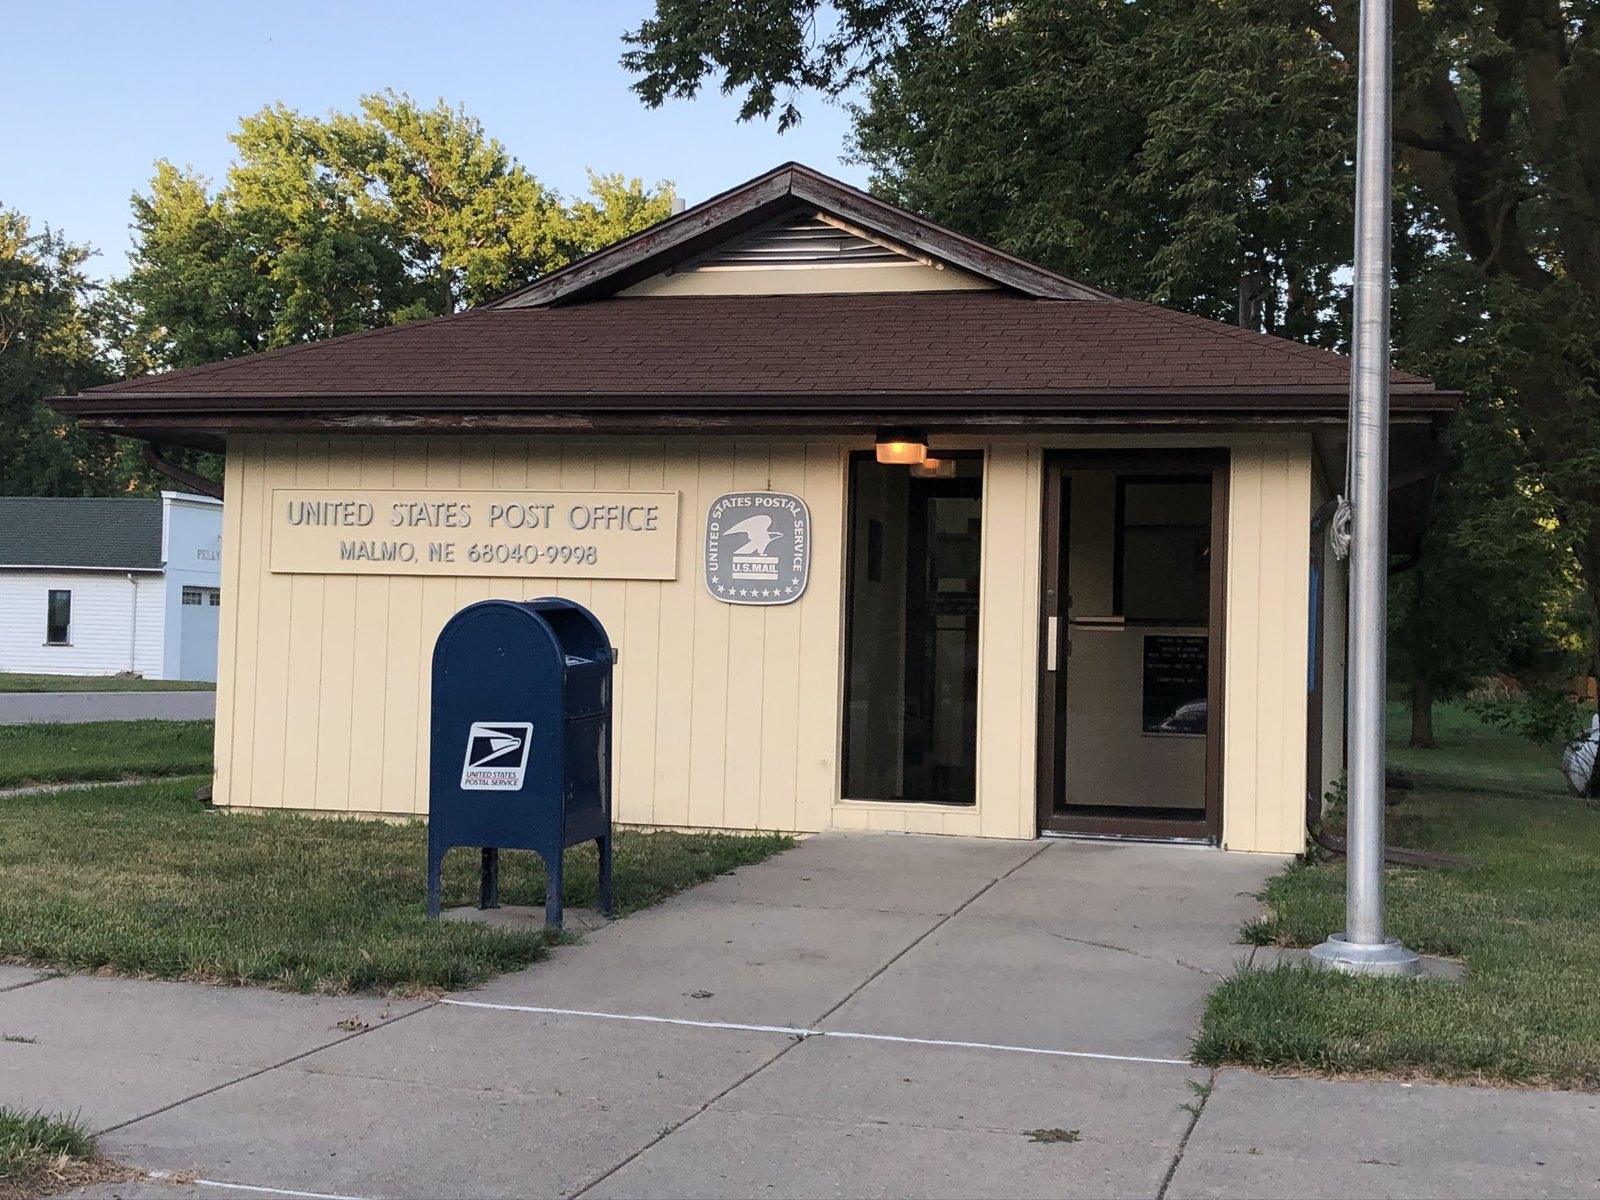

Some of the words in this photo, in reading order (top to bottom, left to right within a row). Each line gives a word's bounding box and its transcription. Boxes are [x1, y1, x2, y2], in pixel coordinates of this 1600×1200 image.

[287, 501, 374, 526] UNITED
[390, 502, 472, 529] STATES
[489, 503, 554, 529] POST
[568, 505, 658, 531] OFFICE
[712, 497, 751, 518] STATES
[755, 497, 801, 518] POSTAL
[340, 541, 419, 564] MALMO,
[429, 543, 456, 563] NE
[468, 543, 599, 565] 68040-9998
[709, 522, 720, 571] UNITED
[793, 520, 803, 572] SERVICE
